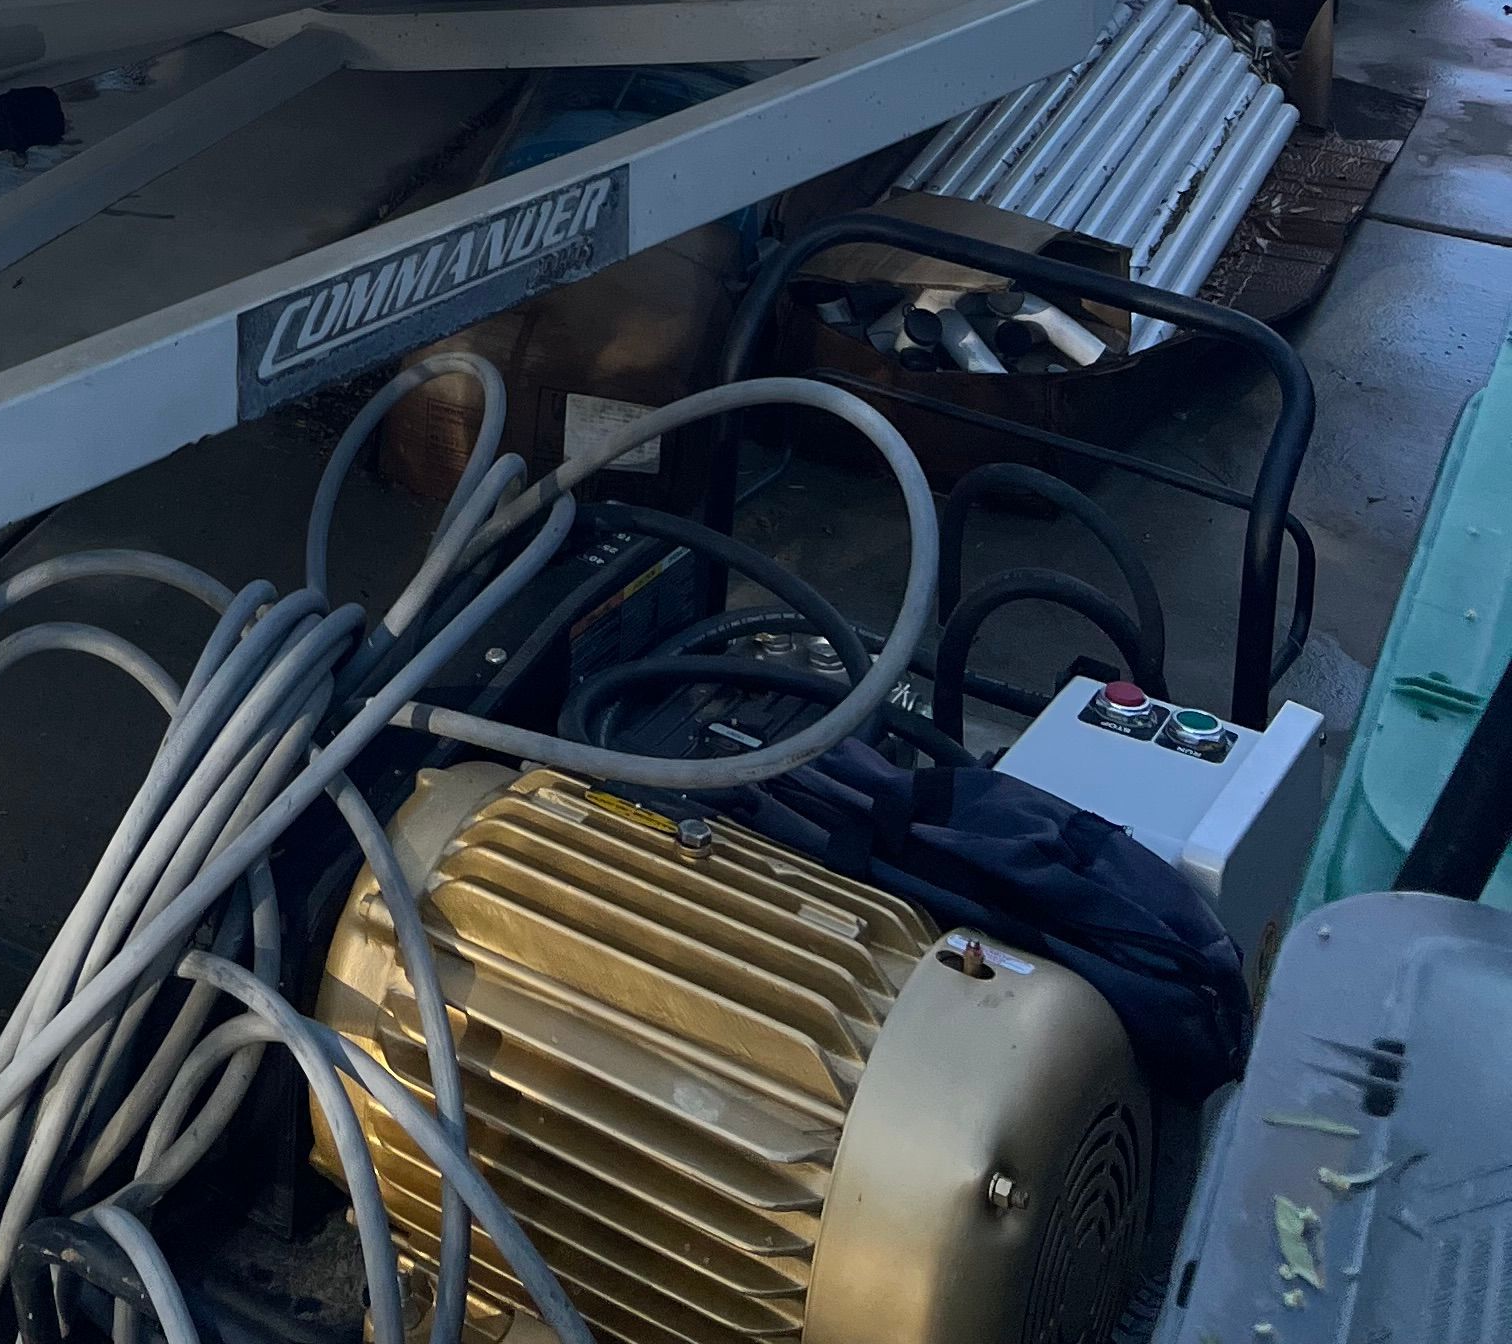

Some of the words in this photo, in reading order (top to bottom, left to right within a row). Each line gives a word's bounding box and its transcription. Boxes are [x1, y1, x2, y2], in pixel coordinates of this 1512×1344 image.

[257, 176, 612, 380] COMMANDER
[1100, 721, 1131, 733] STOP
[1176, 746, 1203, 758] RUN
